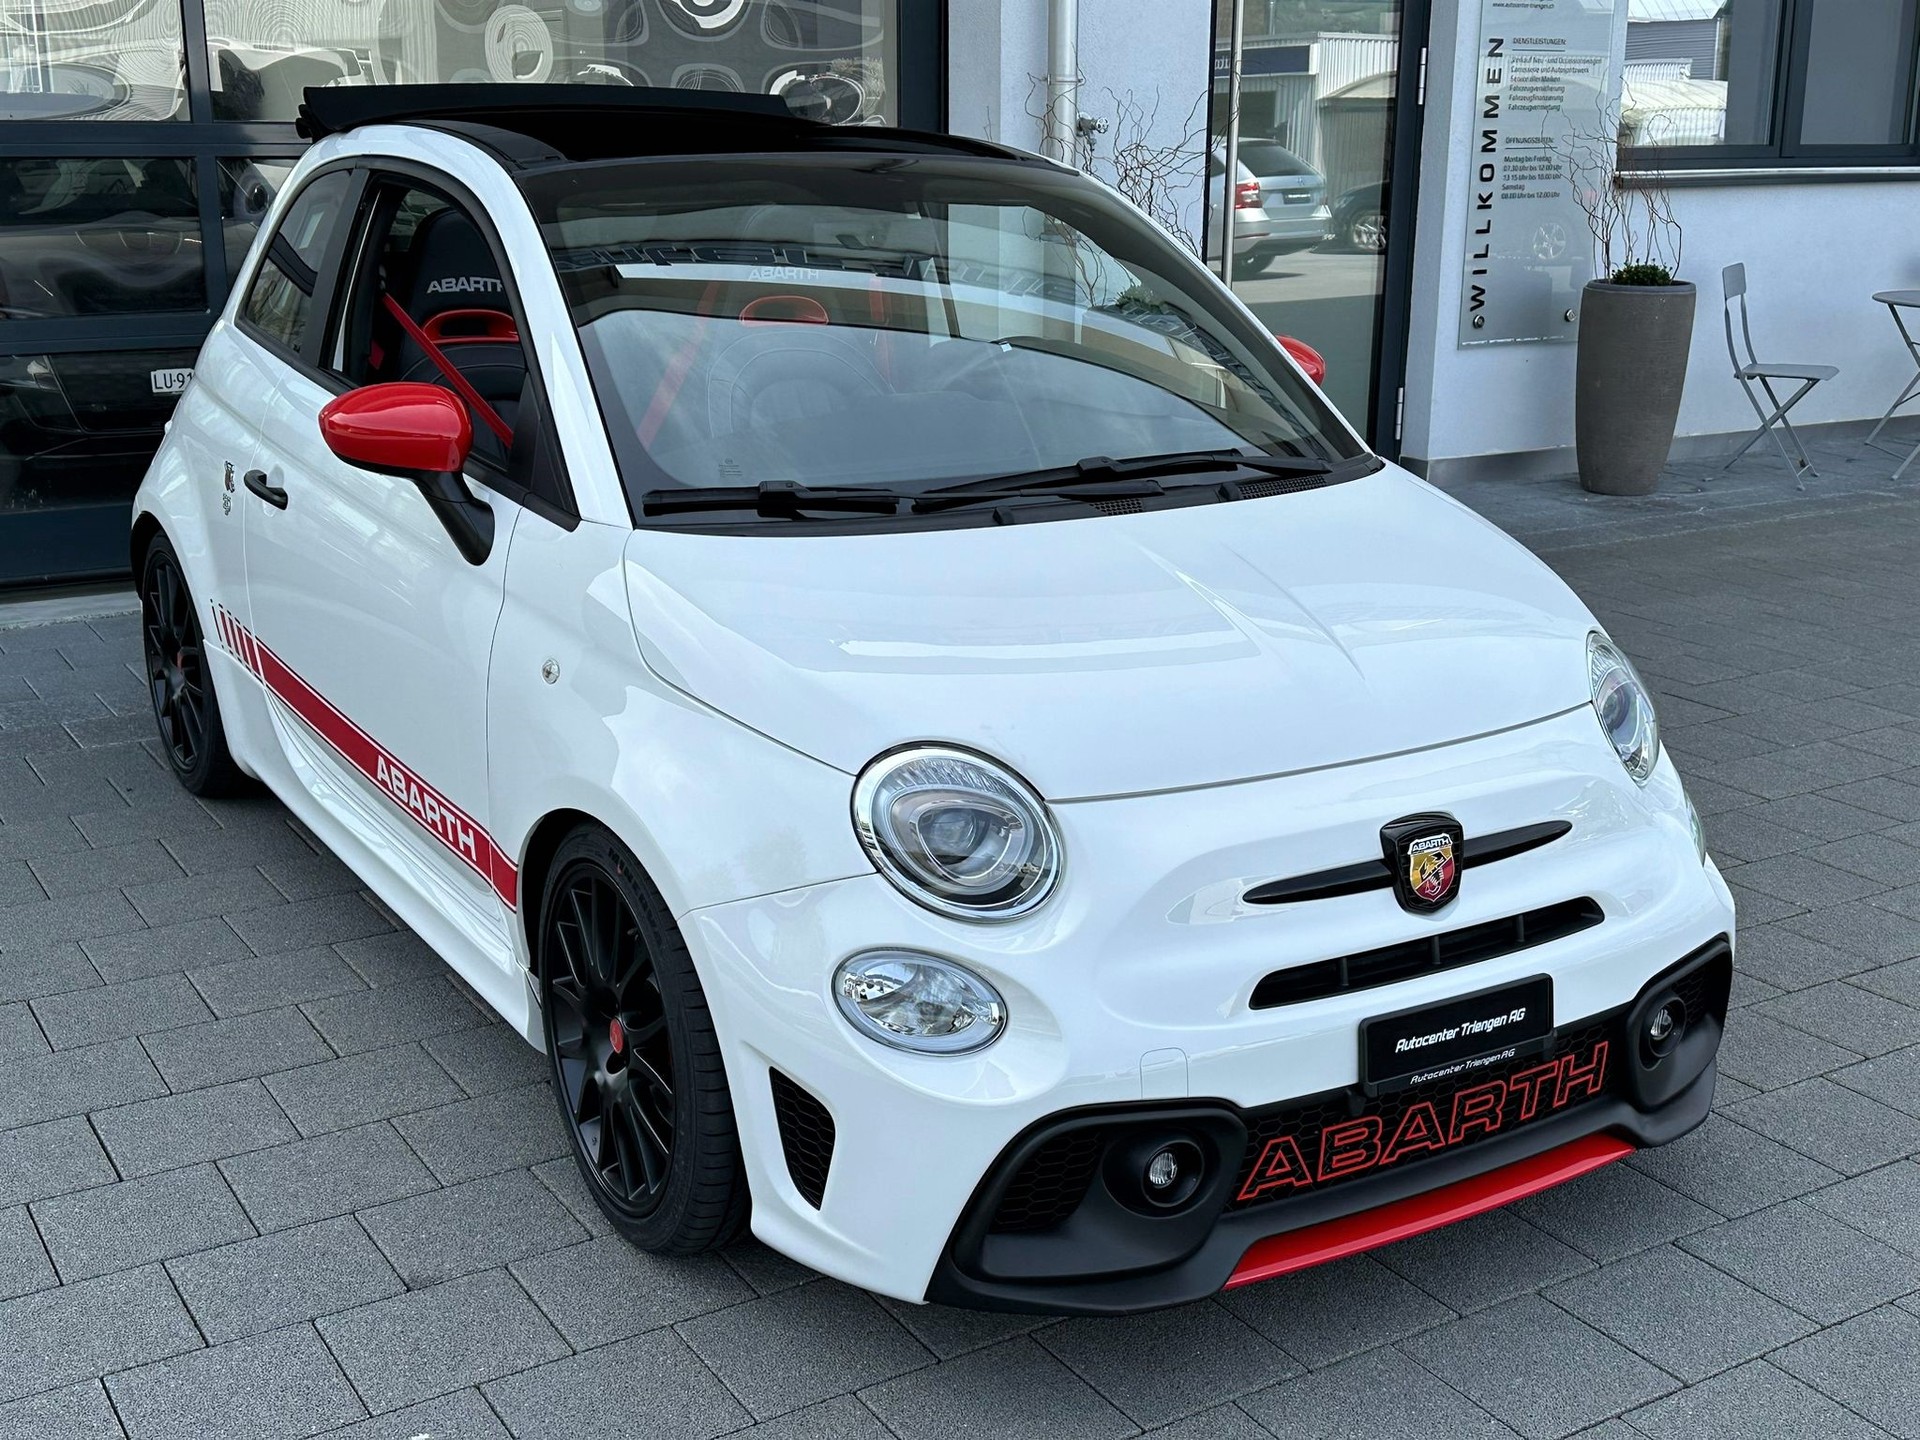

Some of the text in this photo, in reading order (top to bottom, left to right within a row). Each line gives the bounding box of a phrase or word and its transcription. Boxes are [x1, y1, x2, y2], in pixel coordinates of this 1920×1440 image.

[1470, 38, 1504, 312] WILLKOMMEN
[749, 266, 819, 280] ABARTH
[376, 754, 477, 862] ABARTH
[1412, 838, 1449, 852] ABARTH
[1395, 1007, 1526, 1053] Autocenter Triengen AG
[1410, 1048, 1516, 1085] Autocenter Triengen AG
[1236, 1040, 1610, 1201] ABARTH
